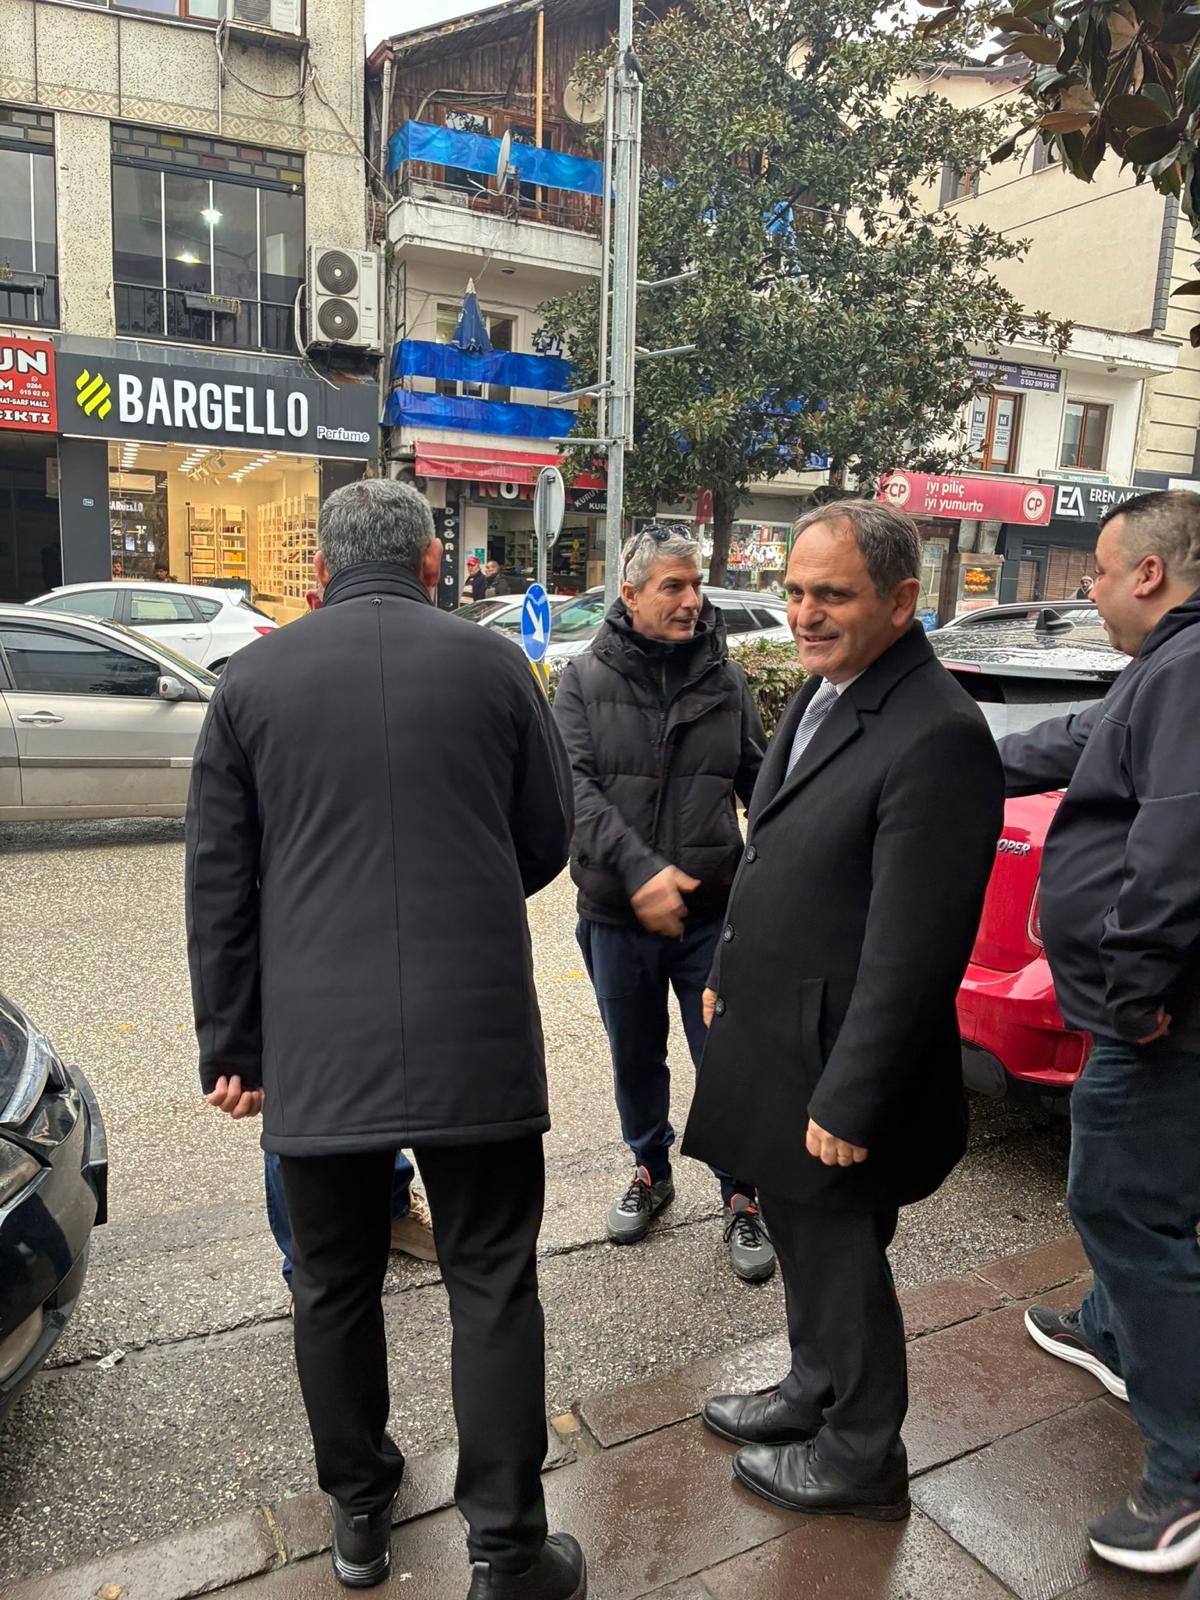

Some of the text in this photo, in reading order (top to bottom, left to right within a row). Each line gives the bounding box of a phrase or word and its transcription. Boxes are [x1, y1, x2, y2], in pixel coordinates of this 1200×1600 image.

[118, 373, 309, 438] BARGELLO
[316, 425, 370, 443] Perfume
[889, 482, 907, 498] CP
[926, 477, 966, 498] iyi piliç
[1089, 488, 1116, 503] EREN
[924, 493, 984, 513] iyi yumurta
[1026, 496, 1043, 512] CP
